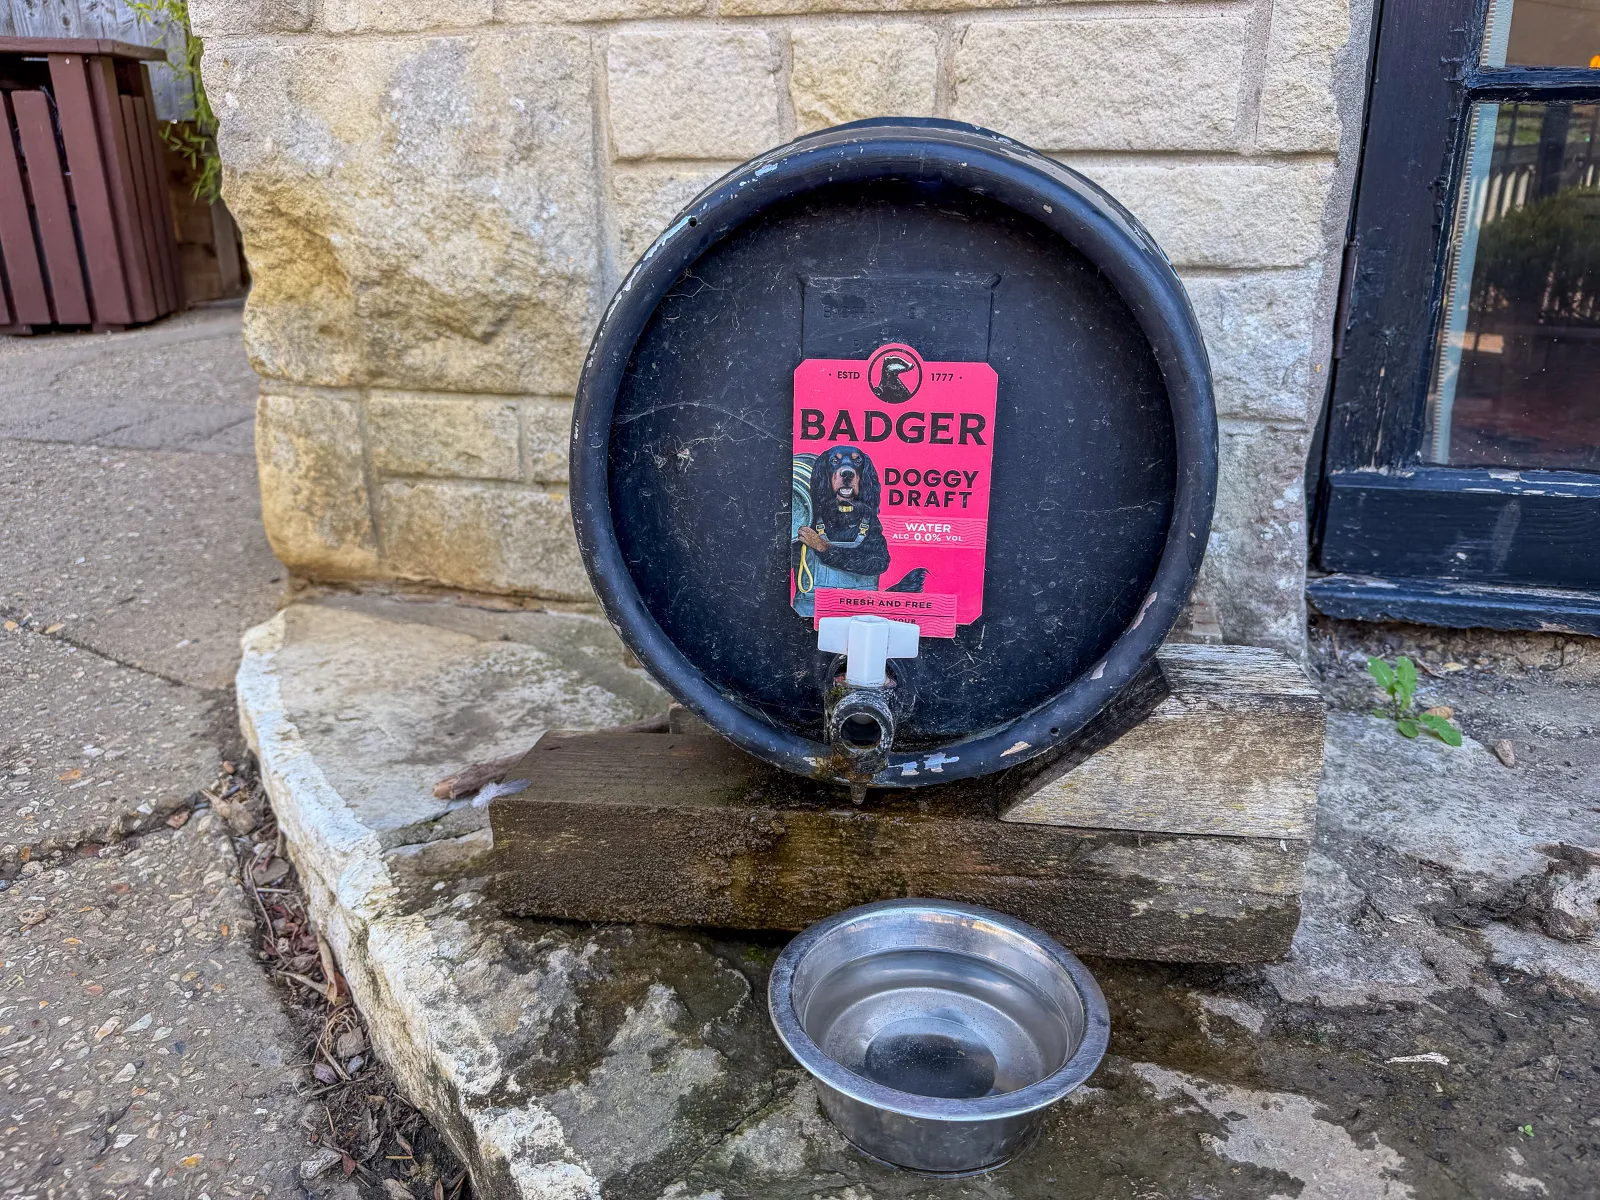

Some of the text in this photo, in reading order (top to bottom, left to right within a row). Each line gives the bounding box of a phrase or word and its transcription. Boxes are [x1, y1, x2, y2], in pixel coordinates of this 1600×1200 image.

[837, 371, 860, 380] ESTD
[931, 372, 954, 382] 1777
[800, 408, 987, 446] BADGER
[884, 468, 980, 489] DOGGY
[888, 489, 973, 509] DRAFT
[905, 522, 951, 533] WATER
[914, 533, 941, 542] 0.0%
[839, 598, 933, 609] FRESH AND FREE
